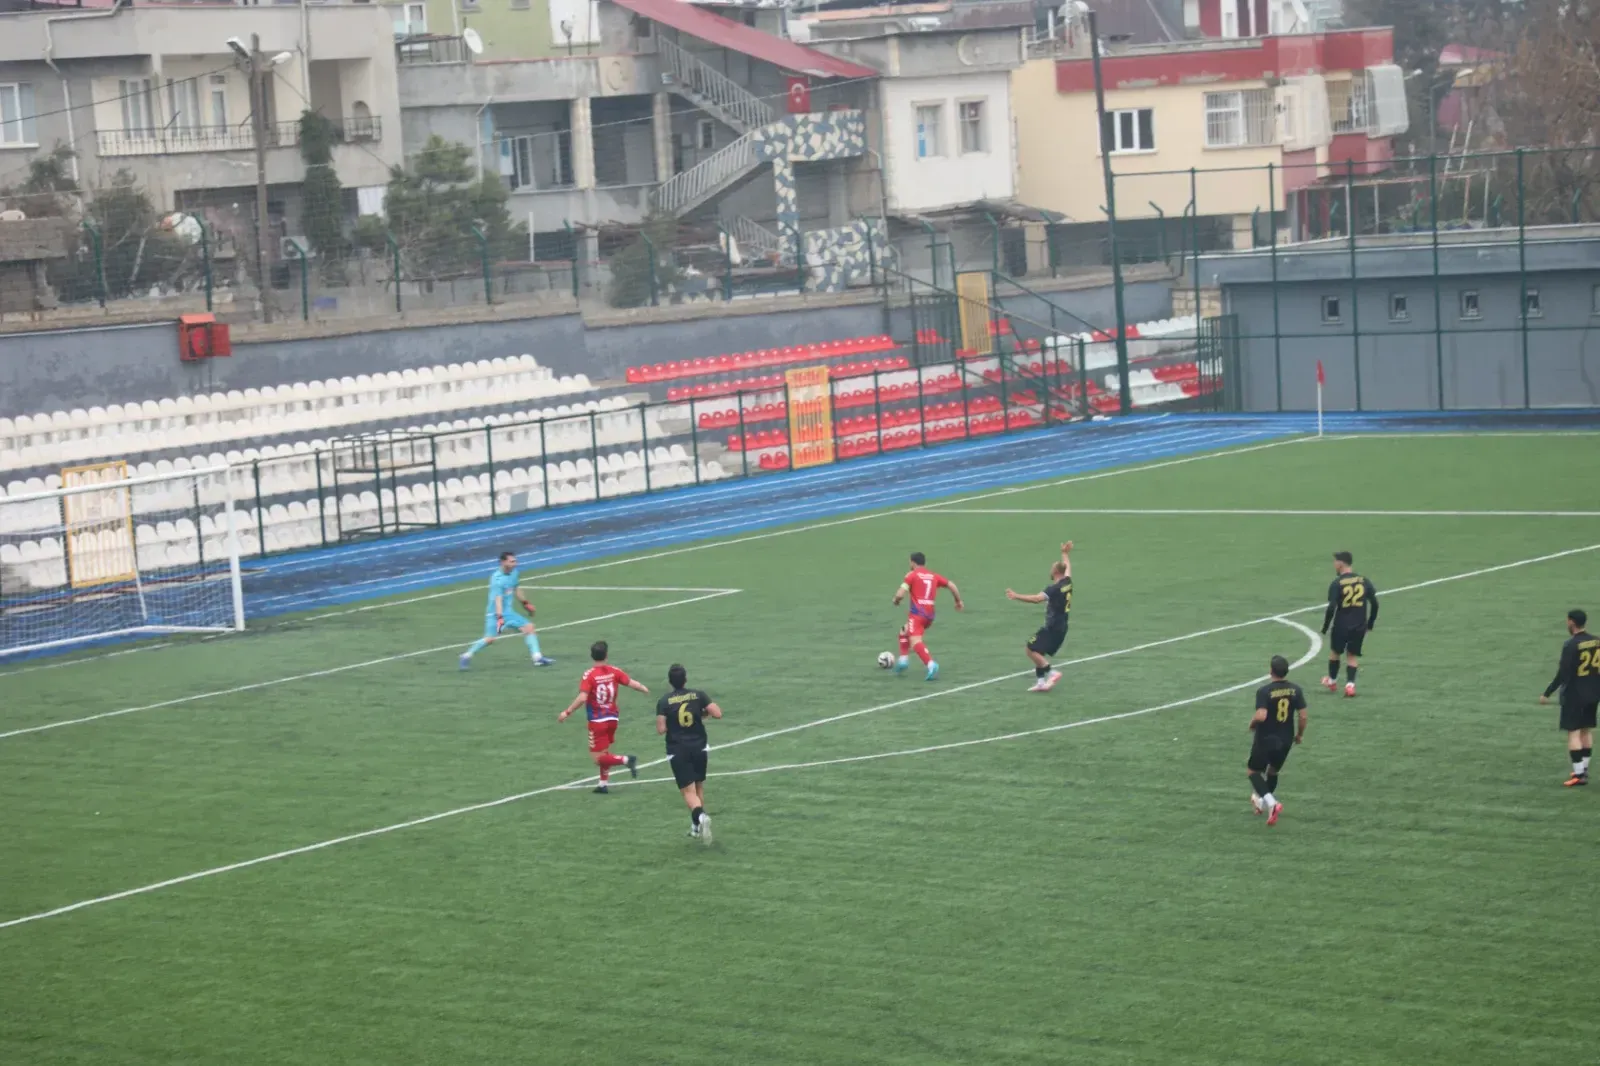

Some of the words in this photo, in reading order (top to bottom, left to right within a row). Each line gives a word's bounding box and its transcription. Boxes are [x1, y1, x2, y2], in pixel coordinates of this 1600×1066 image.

[923, 579, 932, 600] 7
[1342, 583, 1364, 607] 22
[1577, 648, 1600, 676] 24
[596, 682, 614, 704] 61
[678, 702, 693, 727] 6
[1276, 698, 1290, 722] 8
